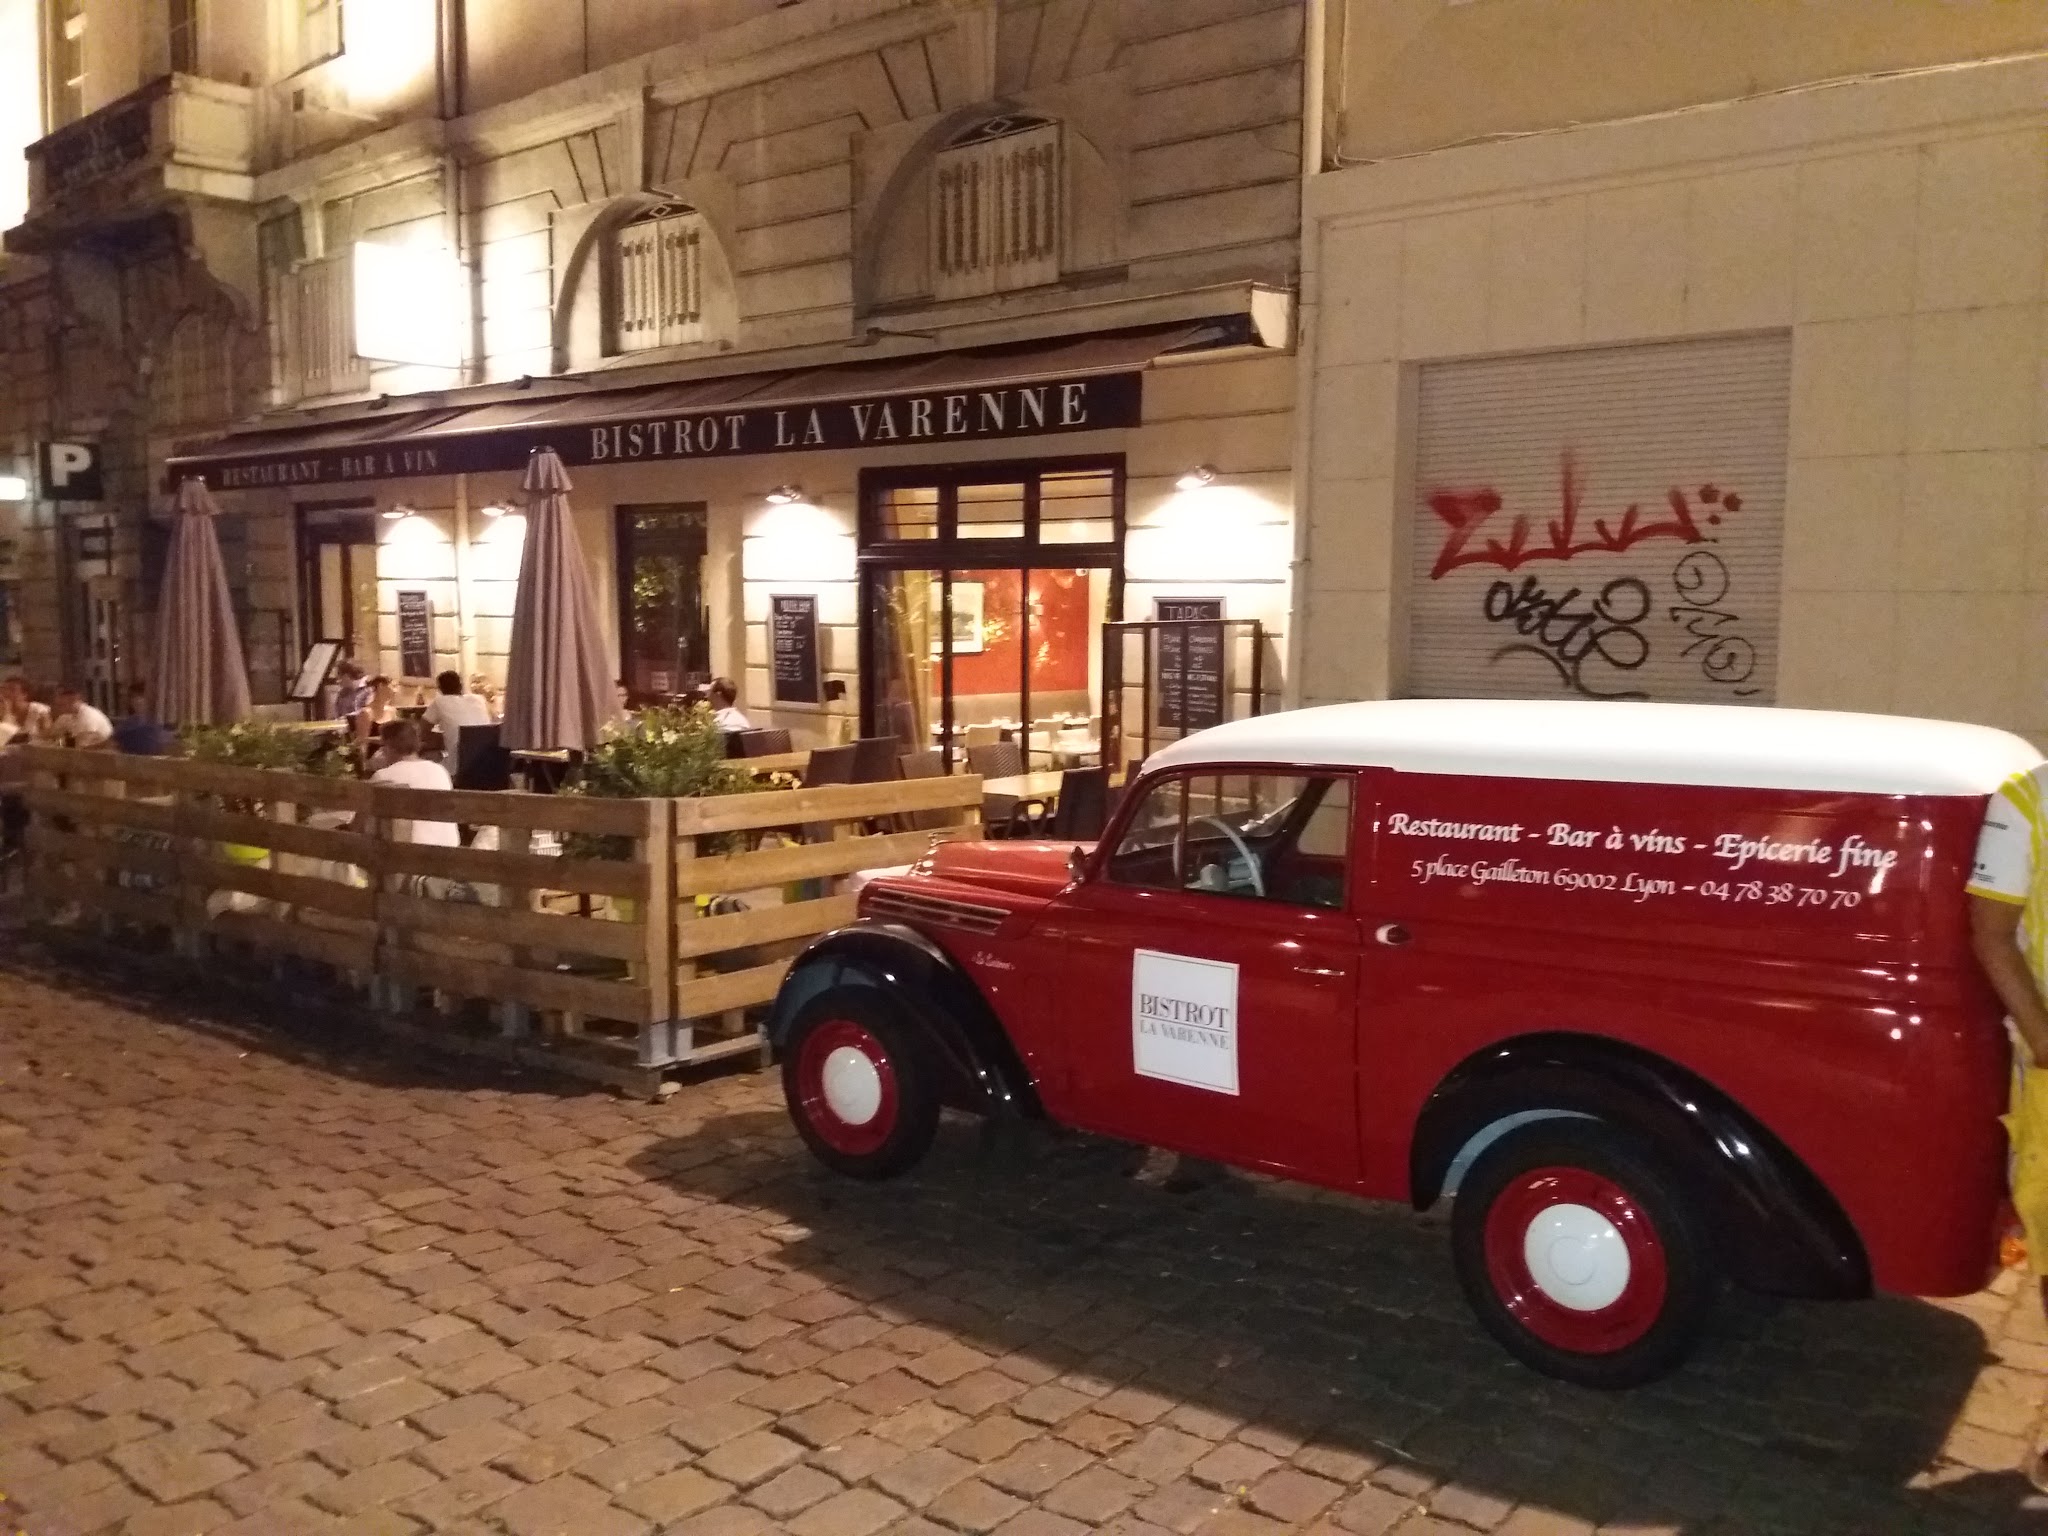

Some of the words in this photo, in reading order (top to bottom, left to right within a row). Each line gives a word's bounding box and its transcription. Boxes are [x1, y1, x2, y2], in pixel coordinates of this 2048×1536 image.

[590, 415, 746, 460] BISTROT
[774, 408, 826, 448] LA
[850, 383, 1088, 441] VARENNE
[50, 443, 92, 487] P
[222, 459, 320, 487] RESTAURANT
[342, 455, 375, 478] BAR
[403, 449, 439, 472] VIN
[1388, 813, 1525, 843] Restaurant
[1547, 822, 1602, 848] Bar
[1605, 825, 1624, 850] à
[1629, 828, 1688, 854] vins
[1713, 833, 1832, 871] Epicerie
[1828, 834, 1898, 878] fine
[1410, 859, 1424, 877] 5
[1419, 854, 1469, 884] place
[1471, 858, 1550, 885] Gailleton
[1553, 868, 1618, 891] 69002
[1621, 872, 1676, 903] Lyon
[1700, 880, 1731, 900] 04
[1733, 880, 1764, 902] 78
[1765, 883, 1794, 905] 38
[1796, 887, 1828, 907] 70
[1829, 890, 1861, 910] 70
[1140, 993, 1229, 1029] BISTROT
[1140, 1020, 1157, 1036] LA
[1161, 1023, 1229, 1050] VARENNE
